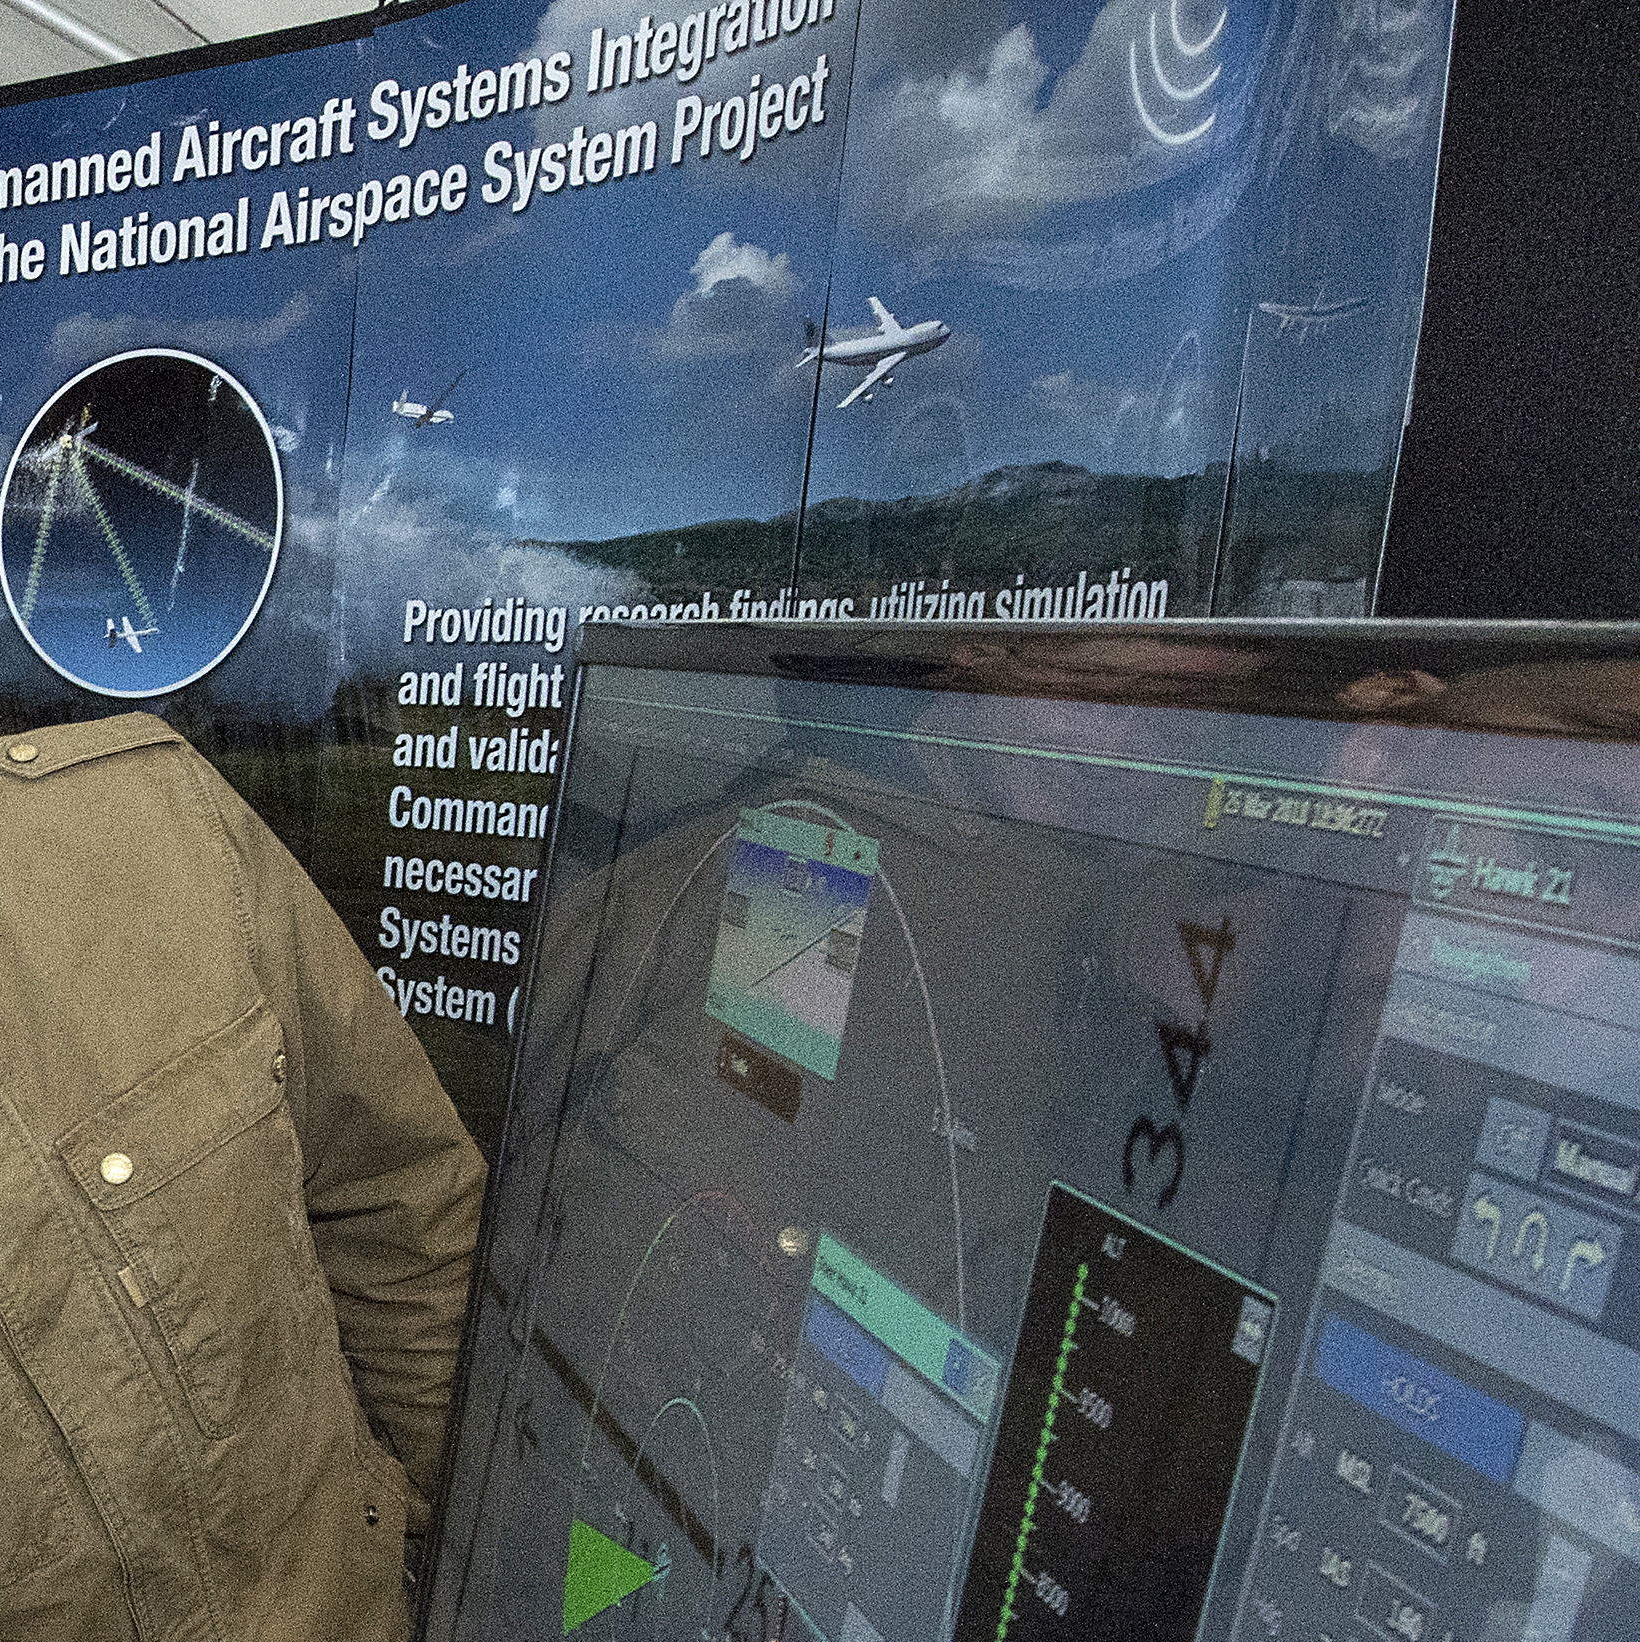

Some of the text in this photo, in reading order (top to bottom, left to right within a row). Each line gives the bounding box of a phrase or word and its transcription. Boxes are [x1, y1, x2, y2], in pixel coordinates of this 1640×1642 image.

[173, 97, 356, 182] Aircraft
[368, 52, 570, 147] Systems
[585, 0, 833, 95] Integration
[59, 197, 249, 275] National
[261, 165, 467, 247] Airspace
[481, 121, 656, 211] System
[670, 56, 828, 162] Project
[403, 597, 567, 652] Providing
[995, 568, 1170, 621] simulation
[397, 662, 564, 717] and flight
[392, 726, 458, 769] and
[383, 855, 539, 902] necessar
[378, 906, 521, 965] Systems
[376, 966, 496, 1025] System
